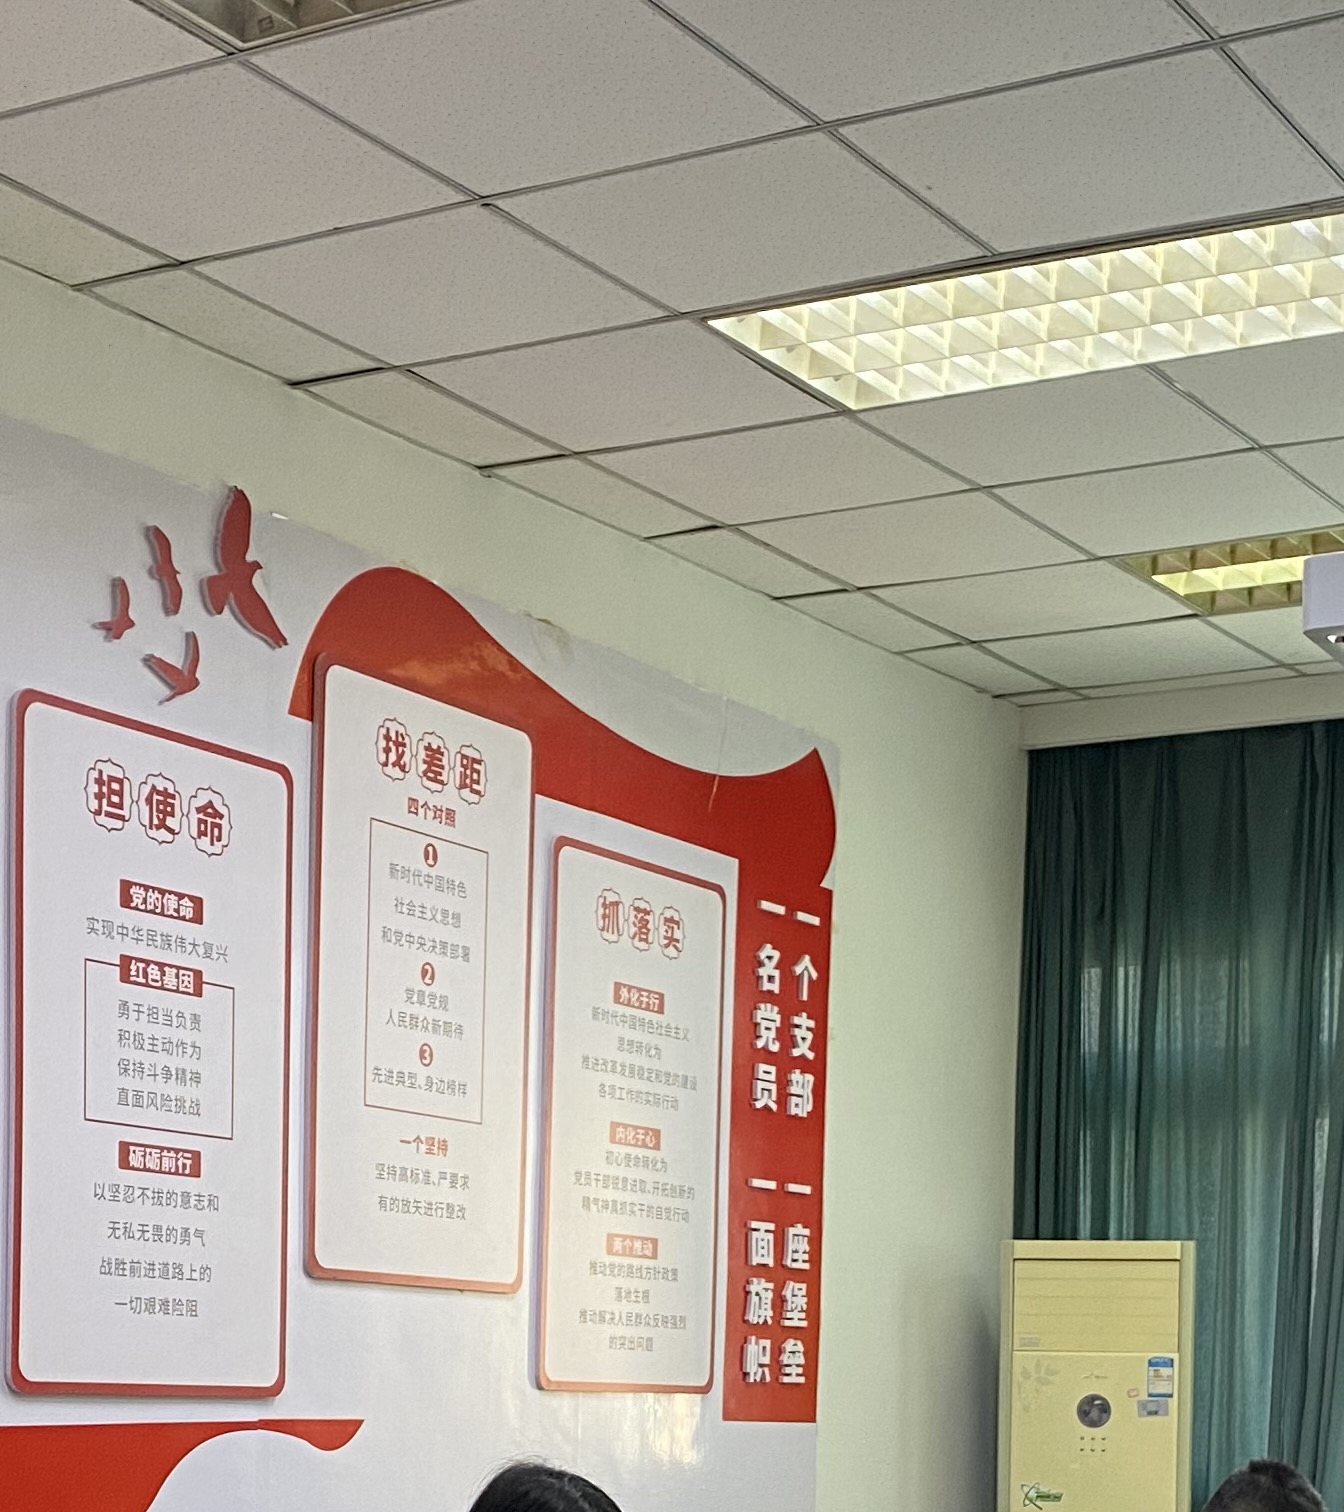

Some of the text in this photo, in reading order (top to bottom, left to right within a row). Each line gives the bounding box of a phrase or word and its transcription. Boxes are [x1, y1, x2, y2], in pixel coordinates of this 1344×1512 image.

[382, 727, 484, 797] 找差距
[94, 769, 225, 846] 担使命
[407, 797, 456, 828] 四个对照
[389, 862, 467, 899] 新时代中国特色
[129, 886, 194, 919] 党的使命
[394, 896, 461, 929] 社会主义思想
[86, 916, 228, 964] 实现中华民族伟大复兴
[601, 895, 682, 953] 抓落实
[129, 960, 194, 994] 红色基因
[117, 999, 202, 1033] 勇于担当负责
[117, 1028, 202, 1061] 积极主动作为
[117, 1058, 202, 1089] 保持斗争精神
[116, 1087, 201, 1118] 直面风险挑战
[399, 1134, 449, 1157] 一个坚持
[742, 900, 786, 1383] 一名党员 一面旗帜
[778, 910, 821, 1384] 一个支部 一座堡垒
[93, 1182, 219, 1212] 以坚忍不拔的意志和
[107, 1220, 205, 1247] 无私无畏的勇气
[99, 1256, 212, 1283] 战胜前进道路上的
[114, 1296, 198, 1317] 一切艰难险阻
